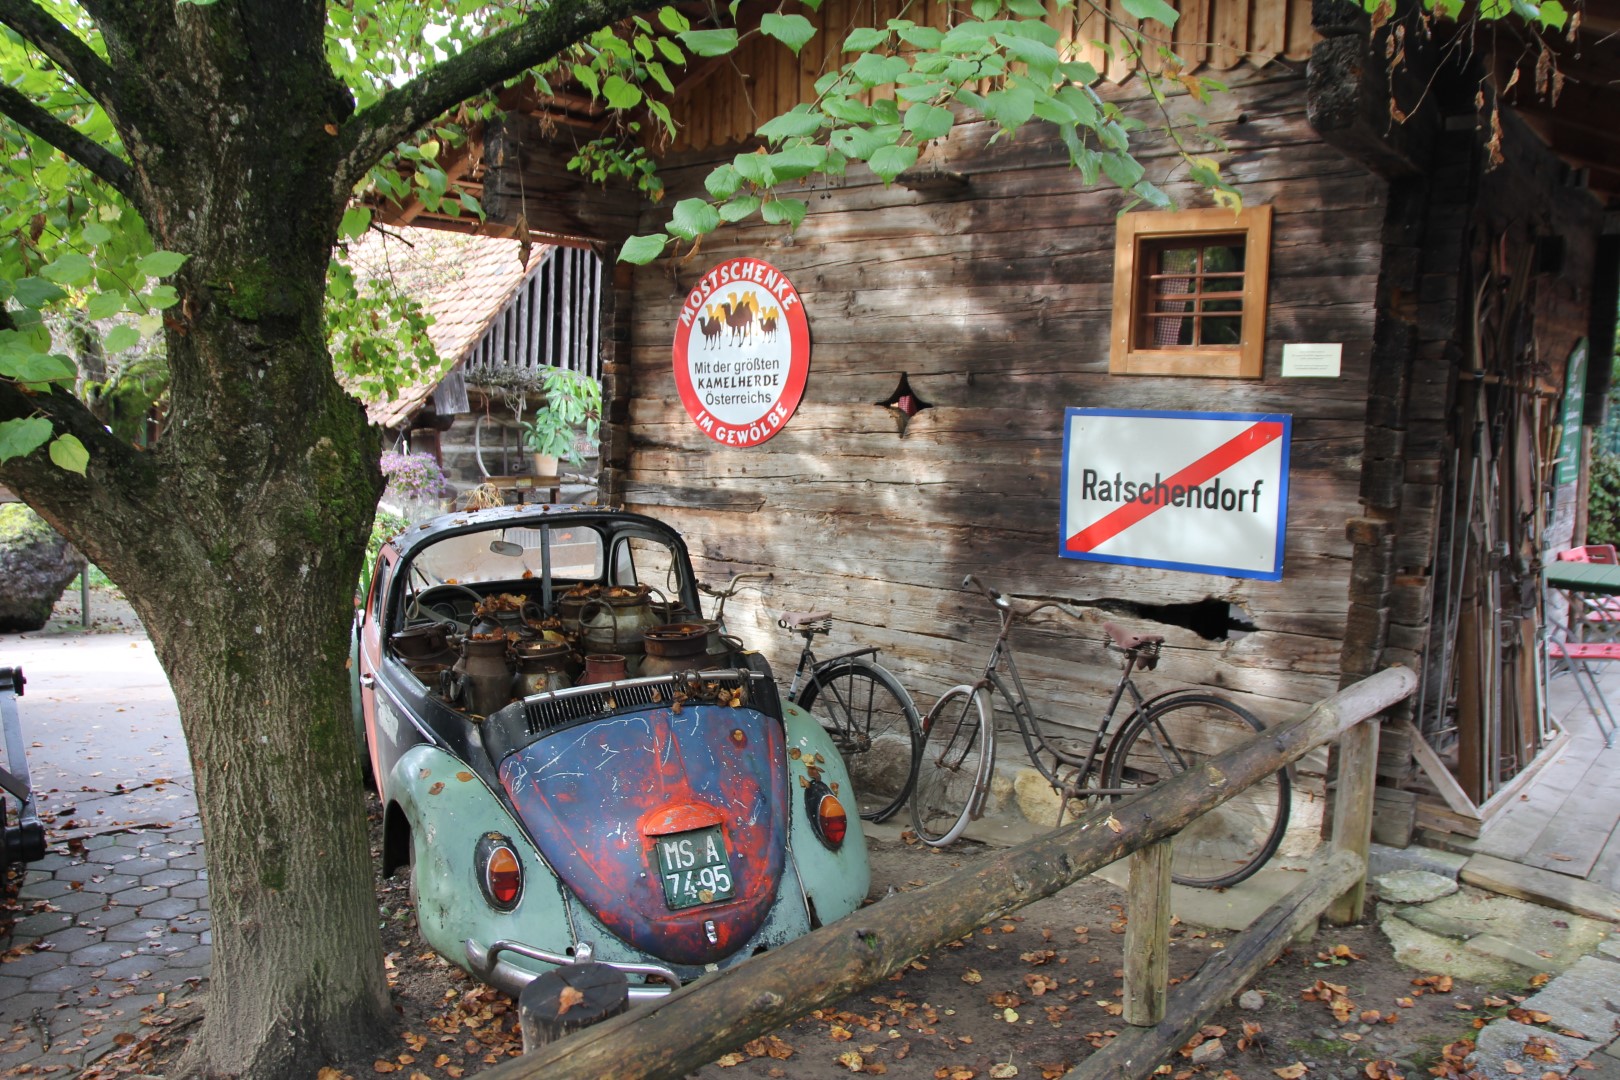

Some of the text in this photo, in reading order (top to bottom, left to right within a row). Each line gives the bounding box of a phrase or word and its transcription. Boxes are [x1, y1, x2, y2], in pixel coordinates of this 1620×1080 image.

[680, 262, 797, 326] MOSTSCHENKE
[694, 357, 779, 375] Mit der größten
[698, 374, 779, 389] KAMELHERDE
[705, 391, 772, 406] Österreichs
[695, 402, 788, 445] IM GEWÖLBE
[1082, 469, 1264, 513] Ratschendorf
[664, 835, 720, 870] MS A
